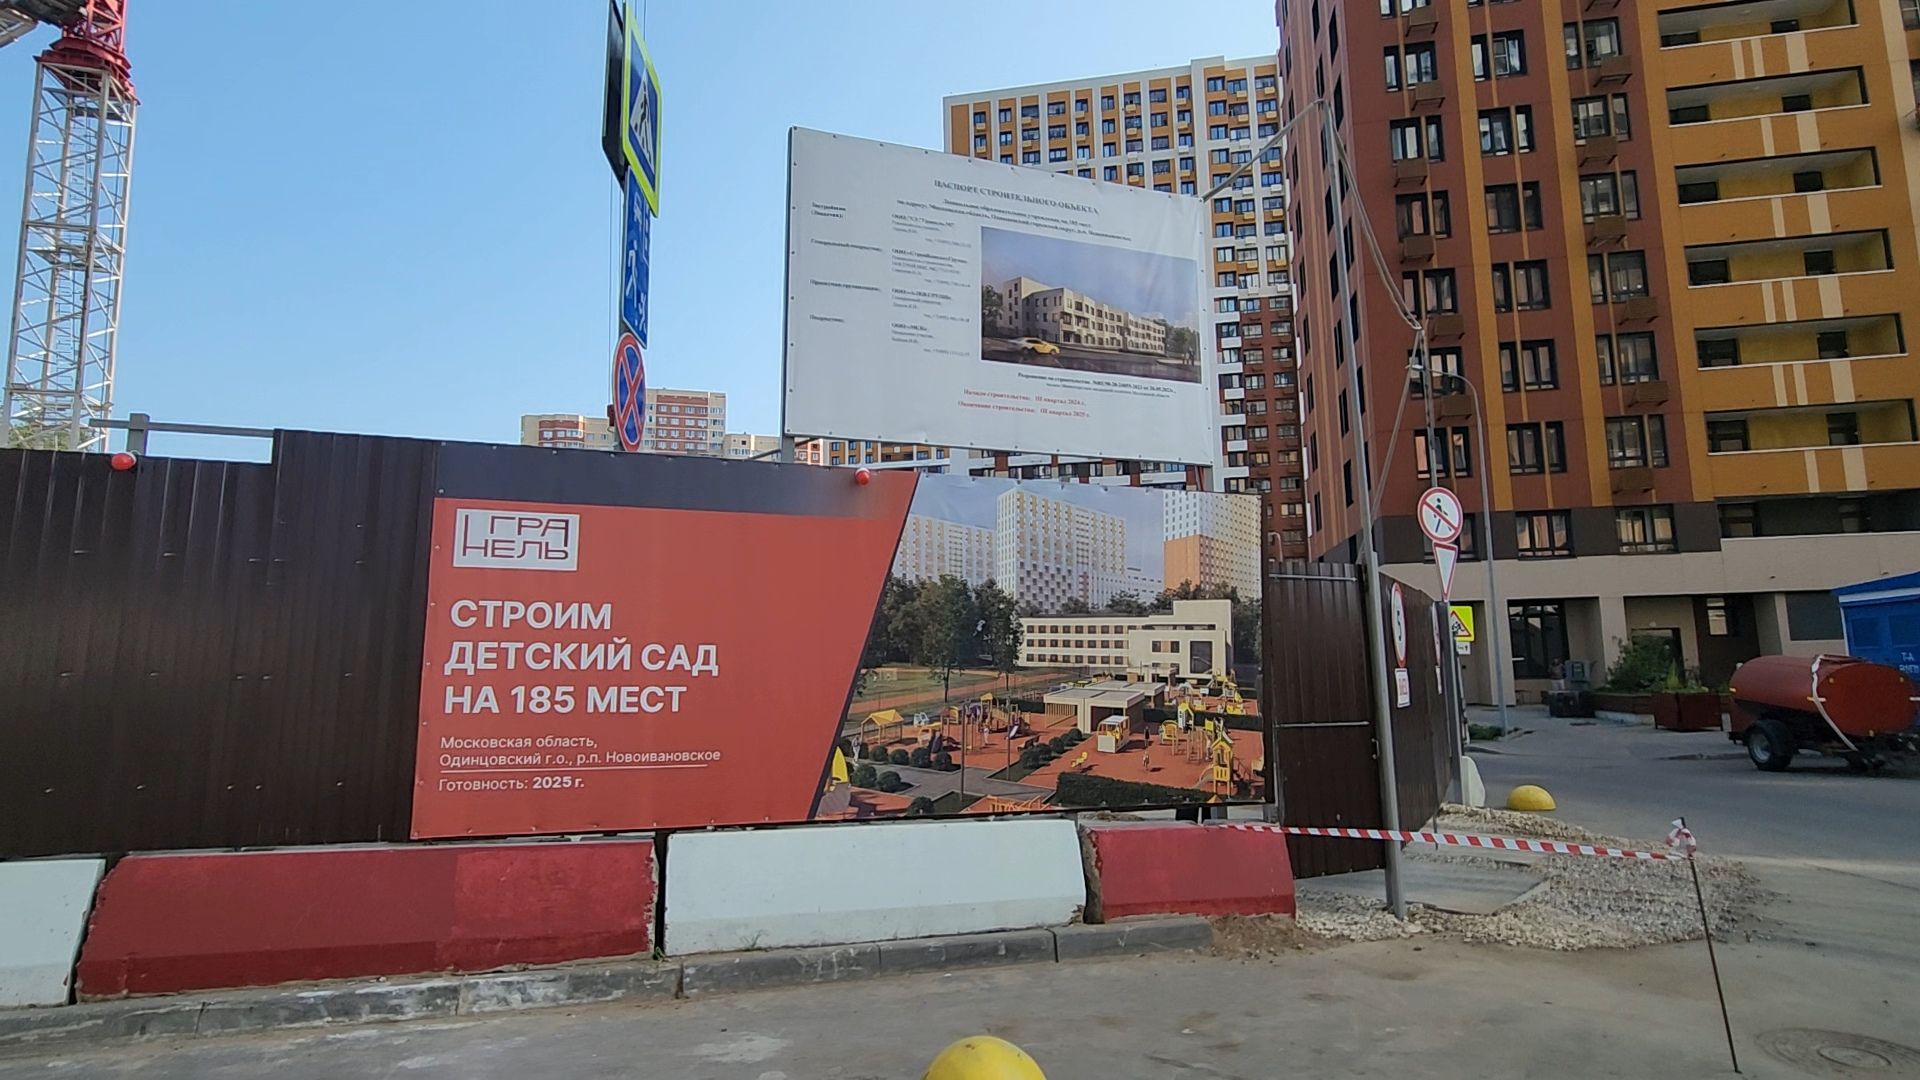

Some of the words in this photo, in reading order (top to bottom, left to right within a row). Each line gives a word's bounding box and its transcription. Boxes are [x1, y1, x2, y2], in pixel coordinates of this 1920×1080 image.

[934, 179, 978, 194] ПАСПОРТ
[489, 515, 569, 548] ГРА
[450, 599, 612, 630] СТРОИМ
[443, 636, 632, 676] ДЕТСКИЙ
[640, 643, 719, 677] САД
[444, 685, 500, 714] НА
[510, 685, 575, 714] 185
[586, 685, 688, 714] МЕСТ
[440, 737, 532, 749] Московская
[536, 734, 598, 749] область,
[439, 752, 542, 768] Одинцовский
[576, 753, 602, 766] р.п.
[605, 749, 721, 763] Новоивановское
[438, 777, 528, 792] Готовность:
[532, 775, 572, 789] 2025
[574, 777, 585, 788] г.
